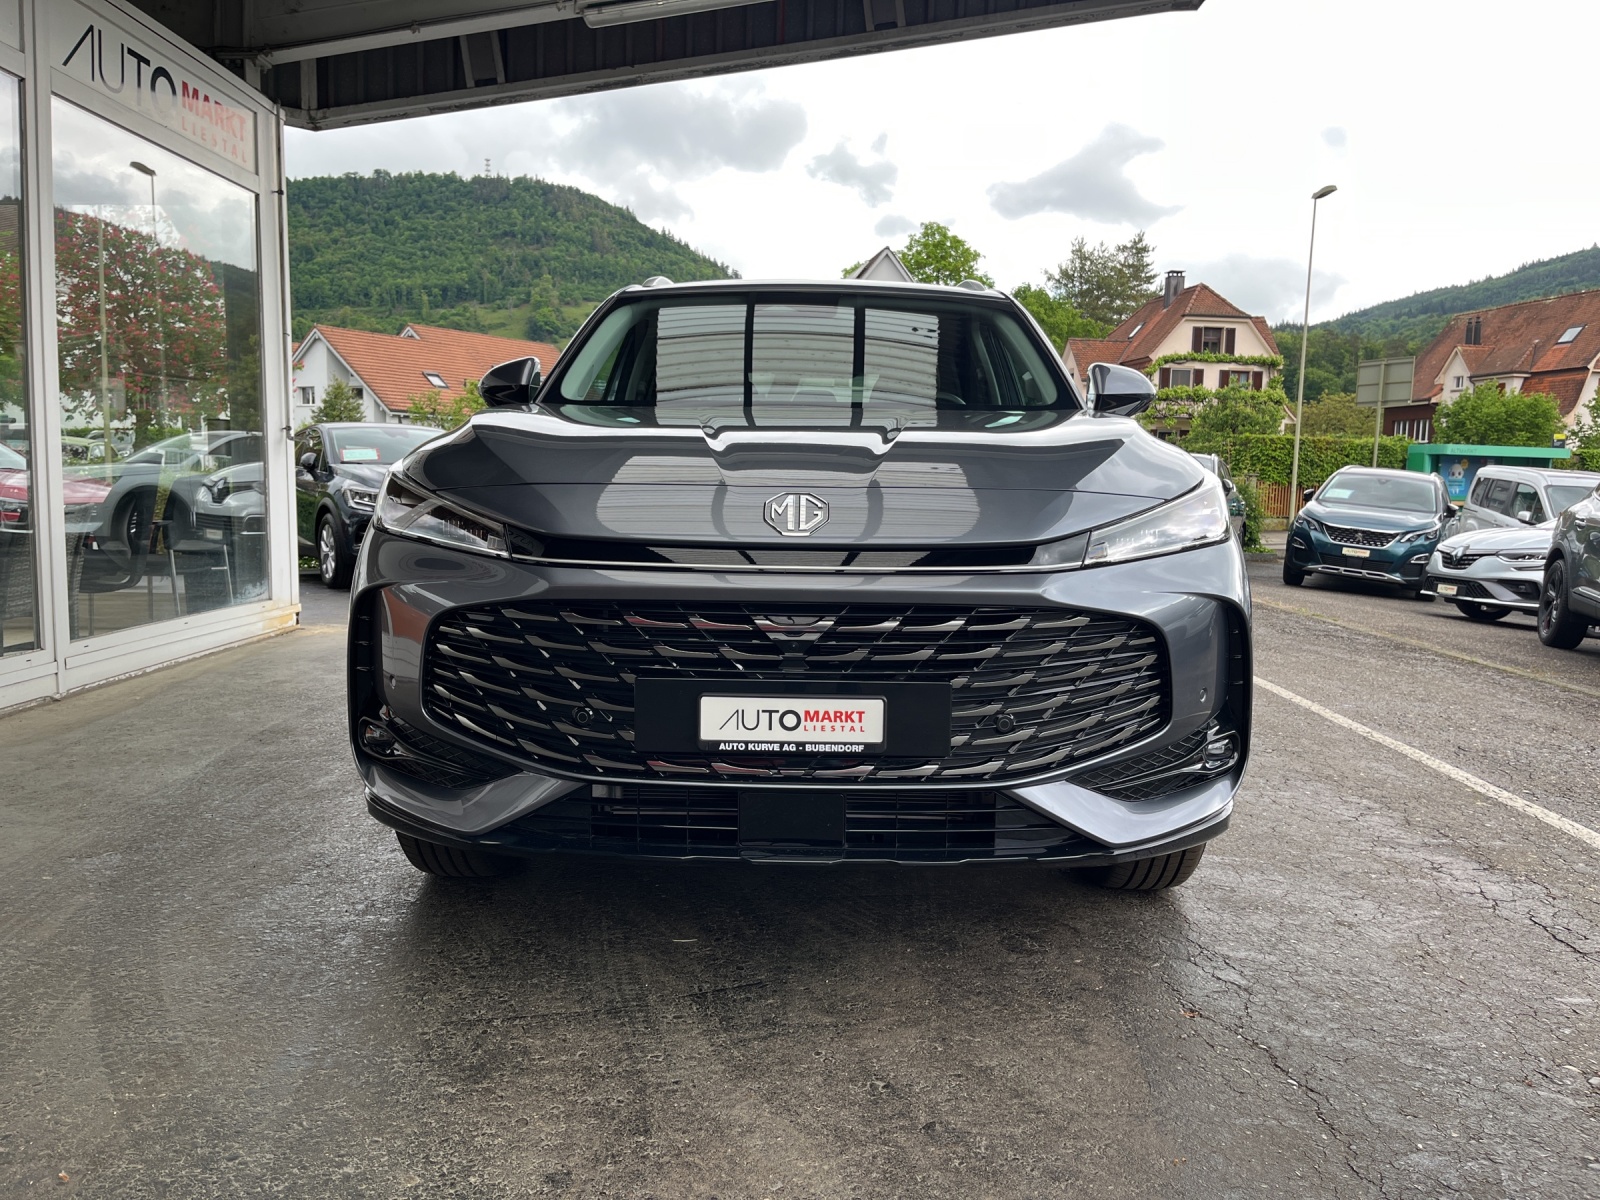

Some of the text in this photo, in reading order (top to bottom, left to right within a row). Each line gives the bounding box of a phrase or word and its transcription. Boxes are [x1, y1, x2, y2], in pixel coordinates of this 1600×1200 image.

[62, 24, 246, 142] AUTO MARKT
[182, 115, 247, 163] LIESTAL
[771, 494, 824, 531] MG
[719, 709, 865, 731] AUTO MARKT
[748, 743, 780, 751] KURVE
[805, 744, 864, 752] BUBENDORF
